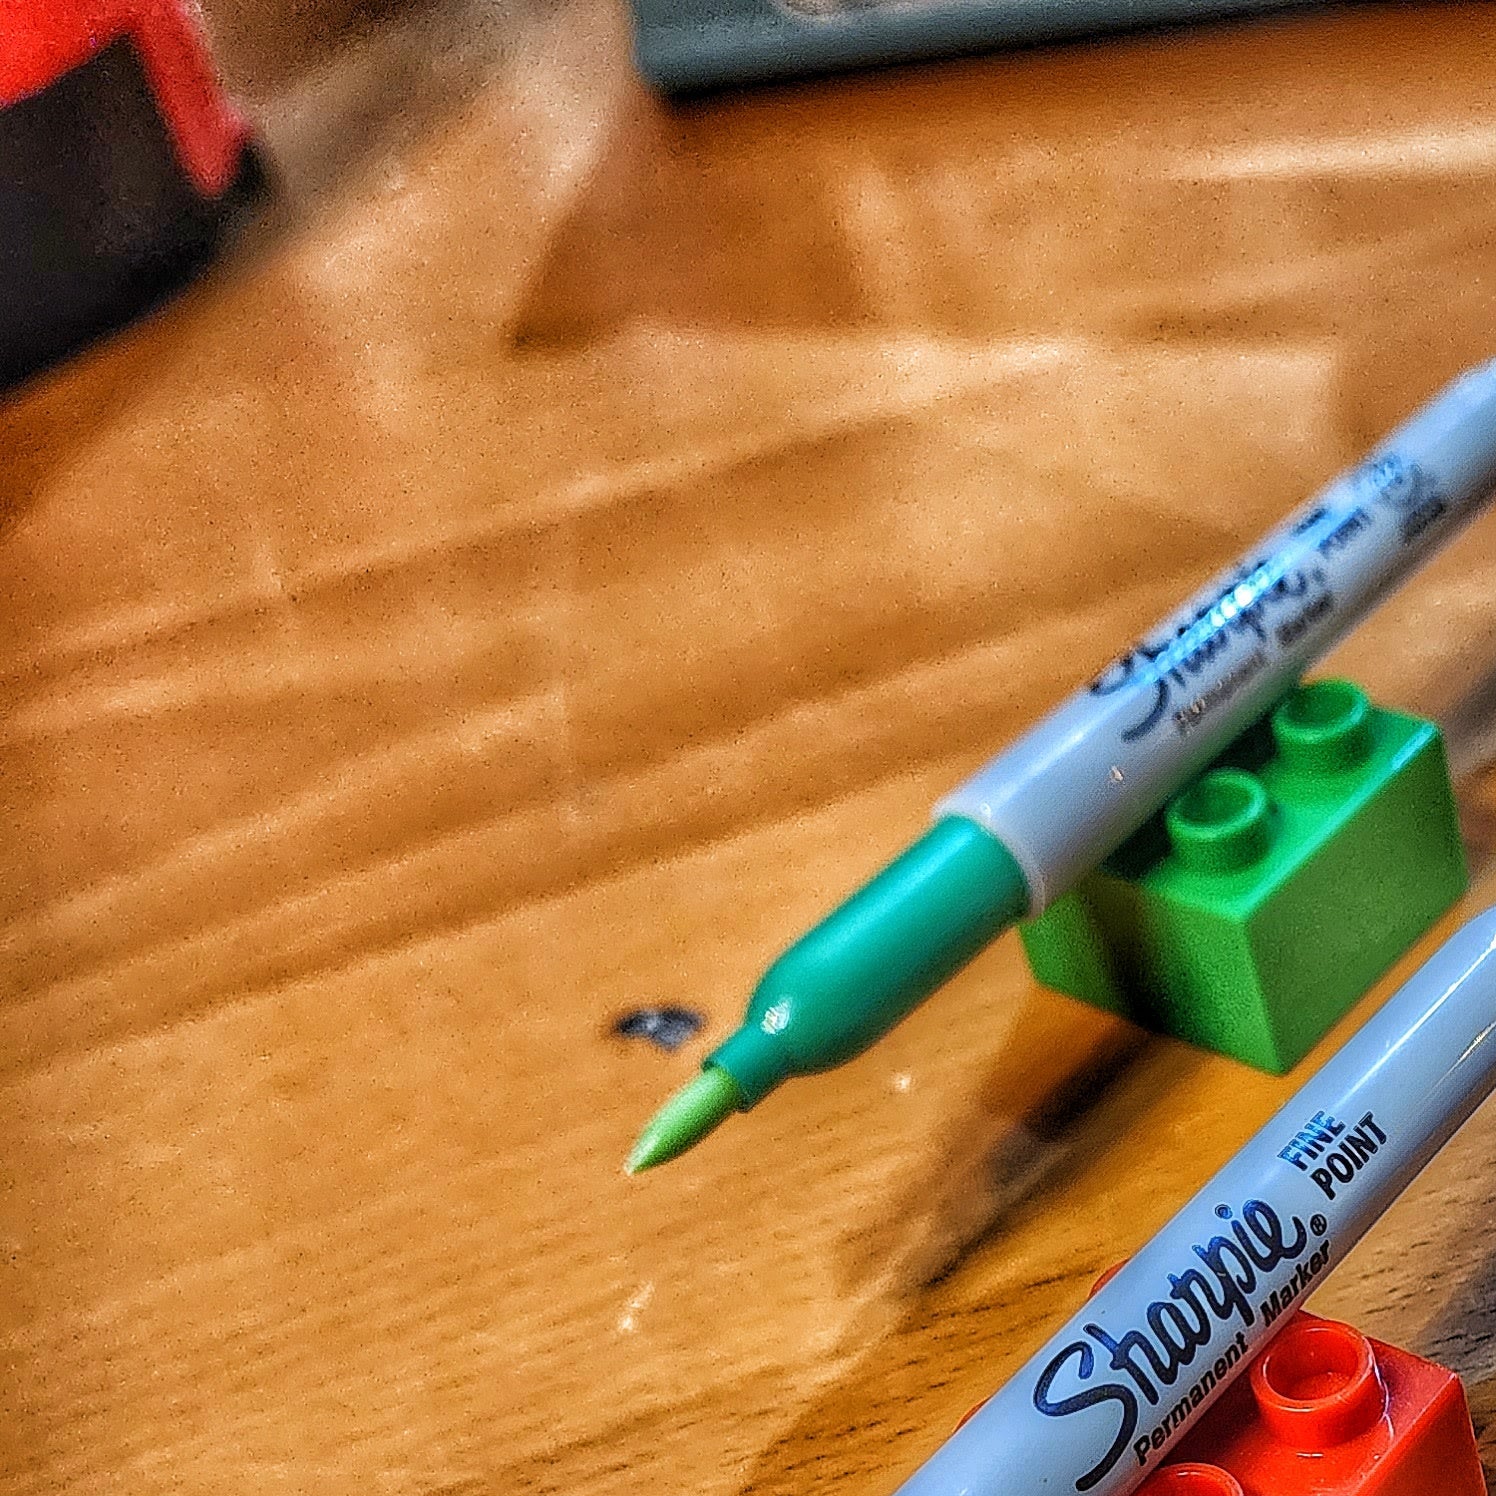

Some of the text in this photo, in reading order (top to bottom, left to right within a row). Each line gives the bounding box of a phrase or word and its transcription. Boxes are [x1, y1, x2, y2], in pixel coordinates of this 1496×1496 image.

[1277, 1110, 1346, 1171] FINE
[1309, 1110, 1388, 1200] POINT
[1033, 1199, 1308, 1492] Sharpie
[1133, 1240, 1331, 1466] Permanent Marker
